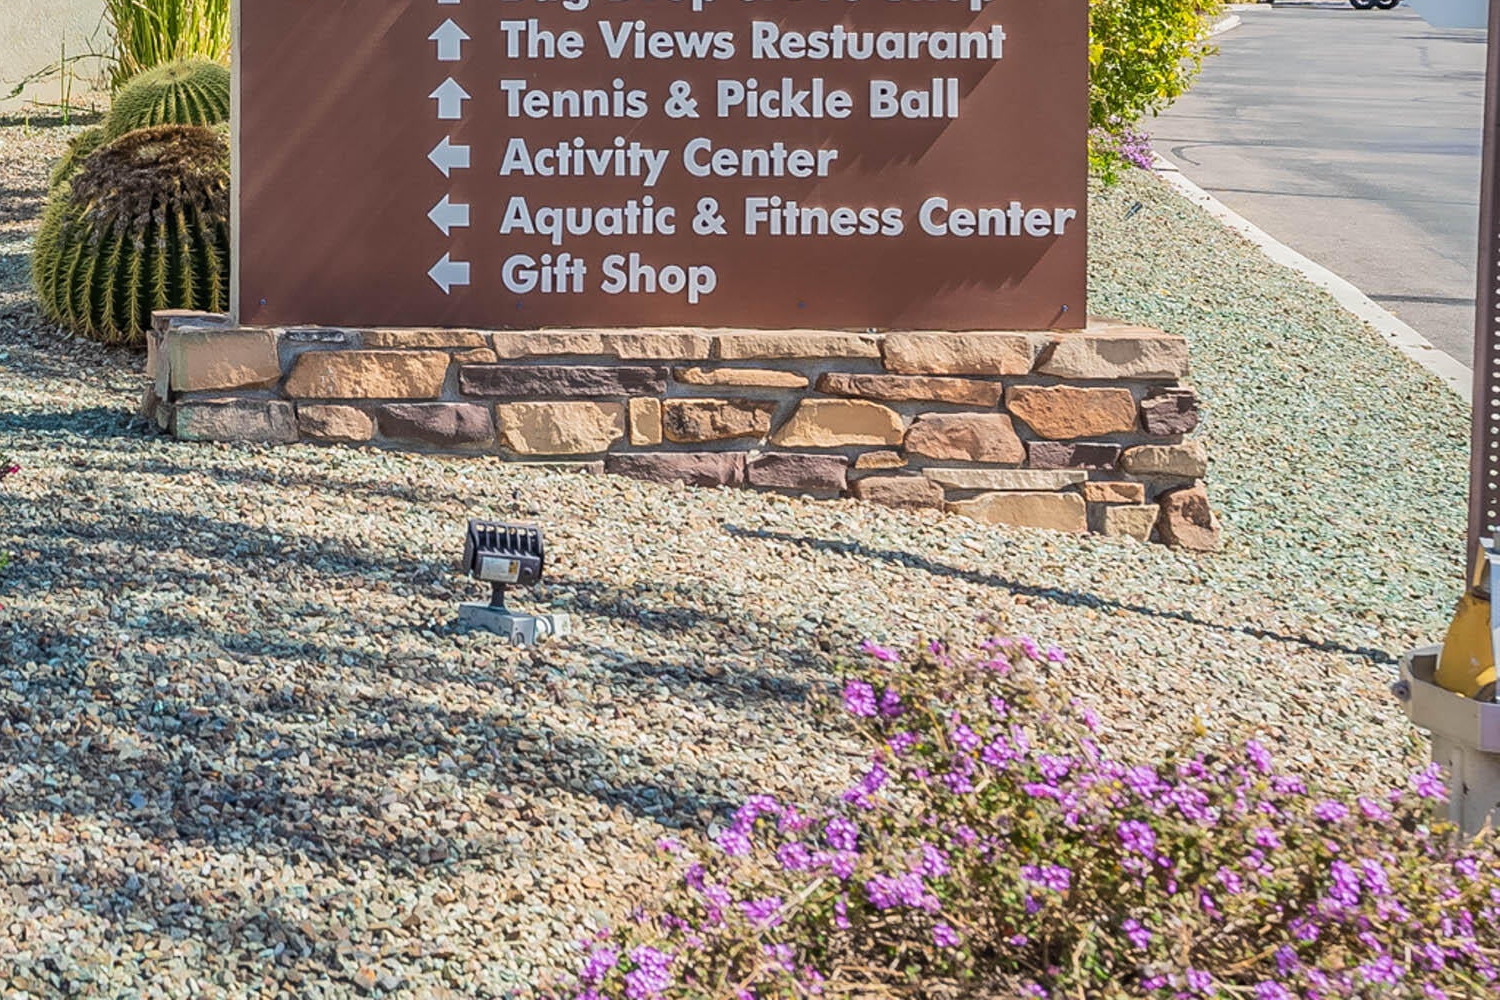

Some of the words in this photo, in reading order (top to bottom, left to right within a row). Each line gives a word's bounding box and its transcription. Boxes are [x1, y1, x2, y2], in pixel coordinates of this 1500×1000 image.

[501, 19, 584, 58] The
[598, 20, 735, 59] Views
[752, 21, 1006, 59] Restuarant
[501, 78, 648, 118] Tennis
[665, 80, 699, 118] &
[718, 78, 852, 118] Pickle
[870, 78, 958, 118] Ball
[500, 136, 669, 186] Activity
[684, 138, 838, 177] Center
[500, 196, 675, 245] Aquatic
[693, 198, 727, 235] &
[746, 196, 904, 235] Fitness
[919, 197, 1076, 236] Center
[502, 253, 586, 293] Gift
[601, 253, 716, 303] Shop
